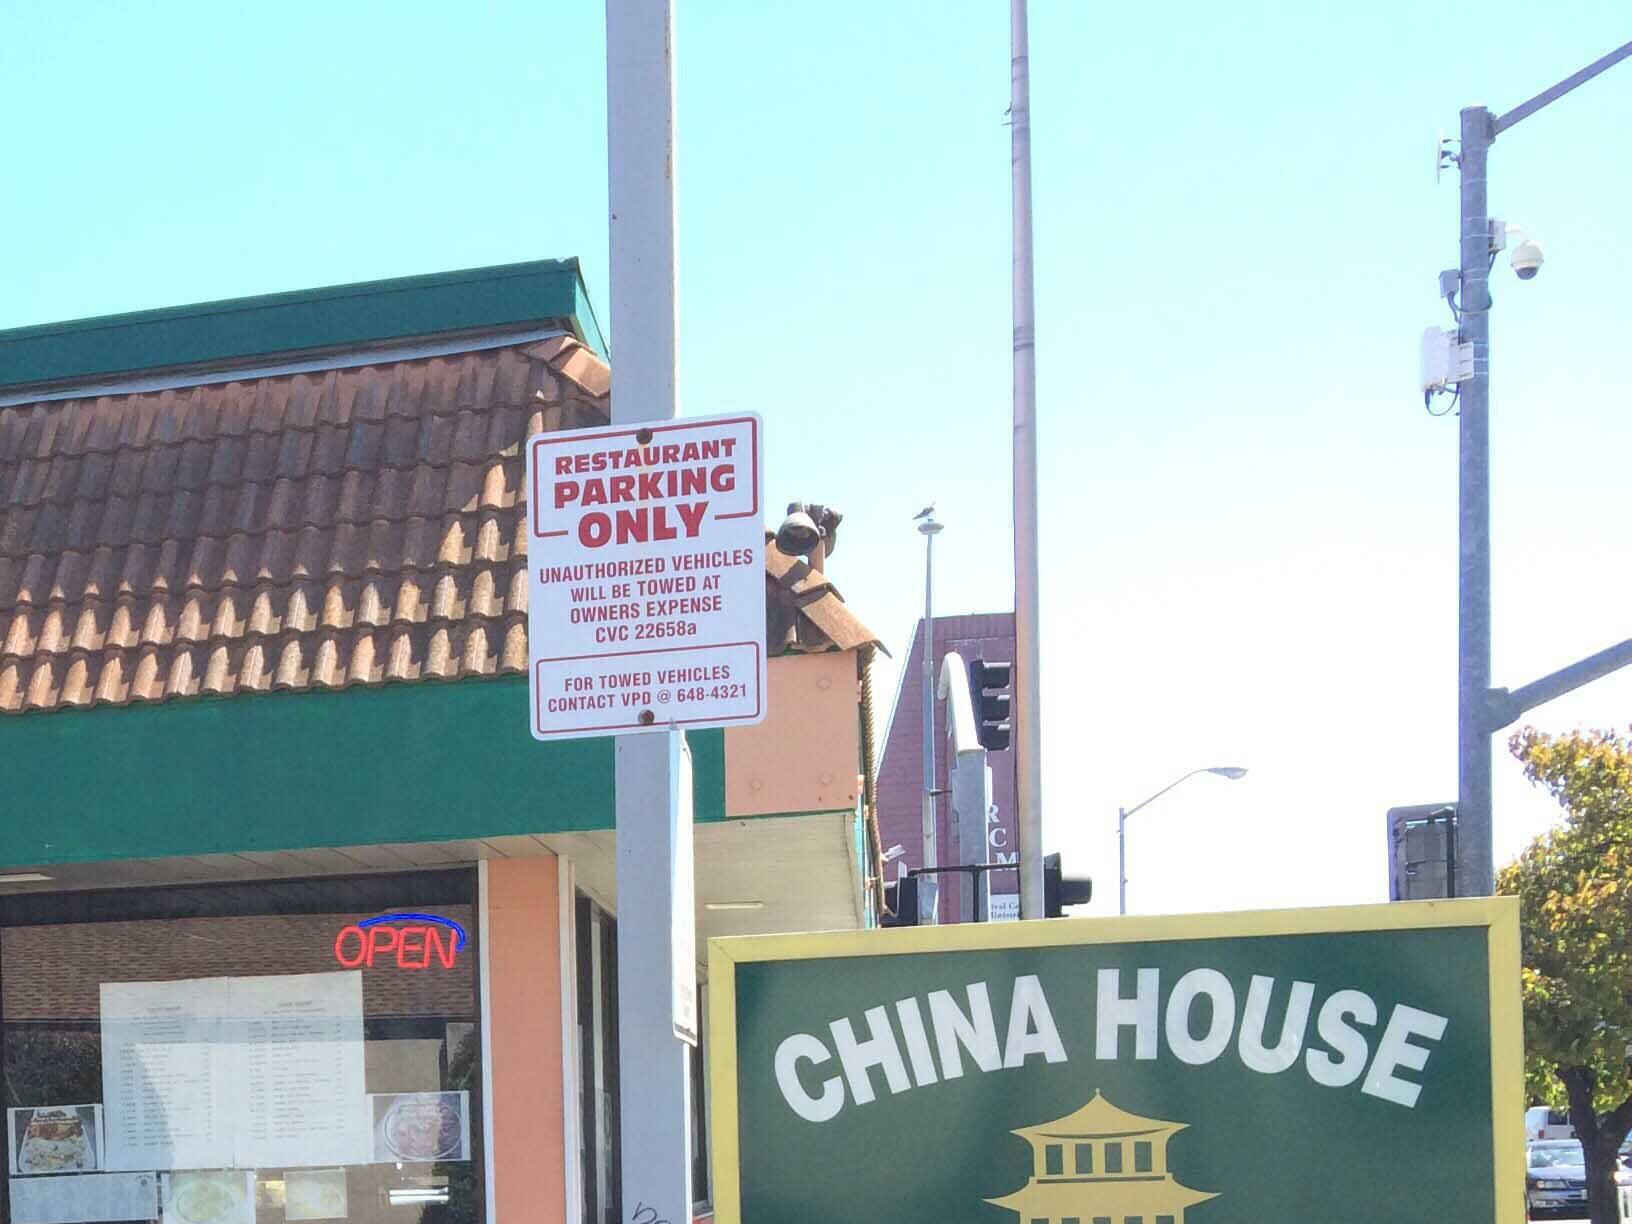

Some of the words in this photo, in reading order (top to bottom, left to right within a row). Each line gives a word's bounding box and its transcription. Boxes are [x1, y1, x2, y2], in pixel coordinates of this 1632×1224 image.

[555, 438, 736, 475] RESTAURANT
[554, 464, 735, 509] PARKING
[578, 501, 709, 548] ONLY
[539, 557, 665, 584] UNAUTHORIZED
[672, 548, 753, 571] VEHICLES
[571, 587, 606, 602] WILL
[612, 583, 630, 598] BE
[637, 576, 696, 596] TOWED
[702, 575, 721, 590] AT
[570, 603, 640, 624] OWNERS
[646, 595, 722, 617] EXPENSE
[596, 625, 628, 643] CVC
[635, 620, 697, 640] 22658a
[564, 677, 593, 691] FOR
[599, 671, 651, 689] TOWED
[657, 665, 730, 684] VEHICLES
[548, 694, 615, 712] CONTACT
[621, 691, 651, 707] VPD
[656, 689, 671, 704] @
[677, 684, 747, 702] 648-4321
[334, 925, 458, 969] OPEN
[773, 974, 1068, 1123] CHINA
[1095, 967, 1449, 1109] HOUSE
